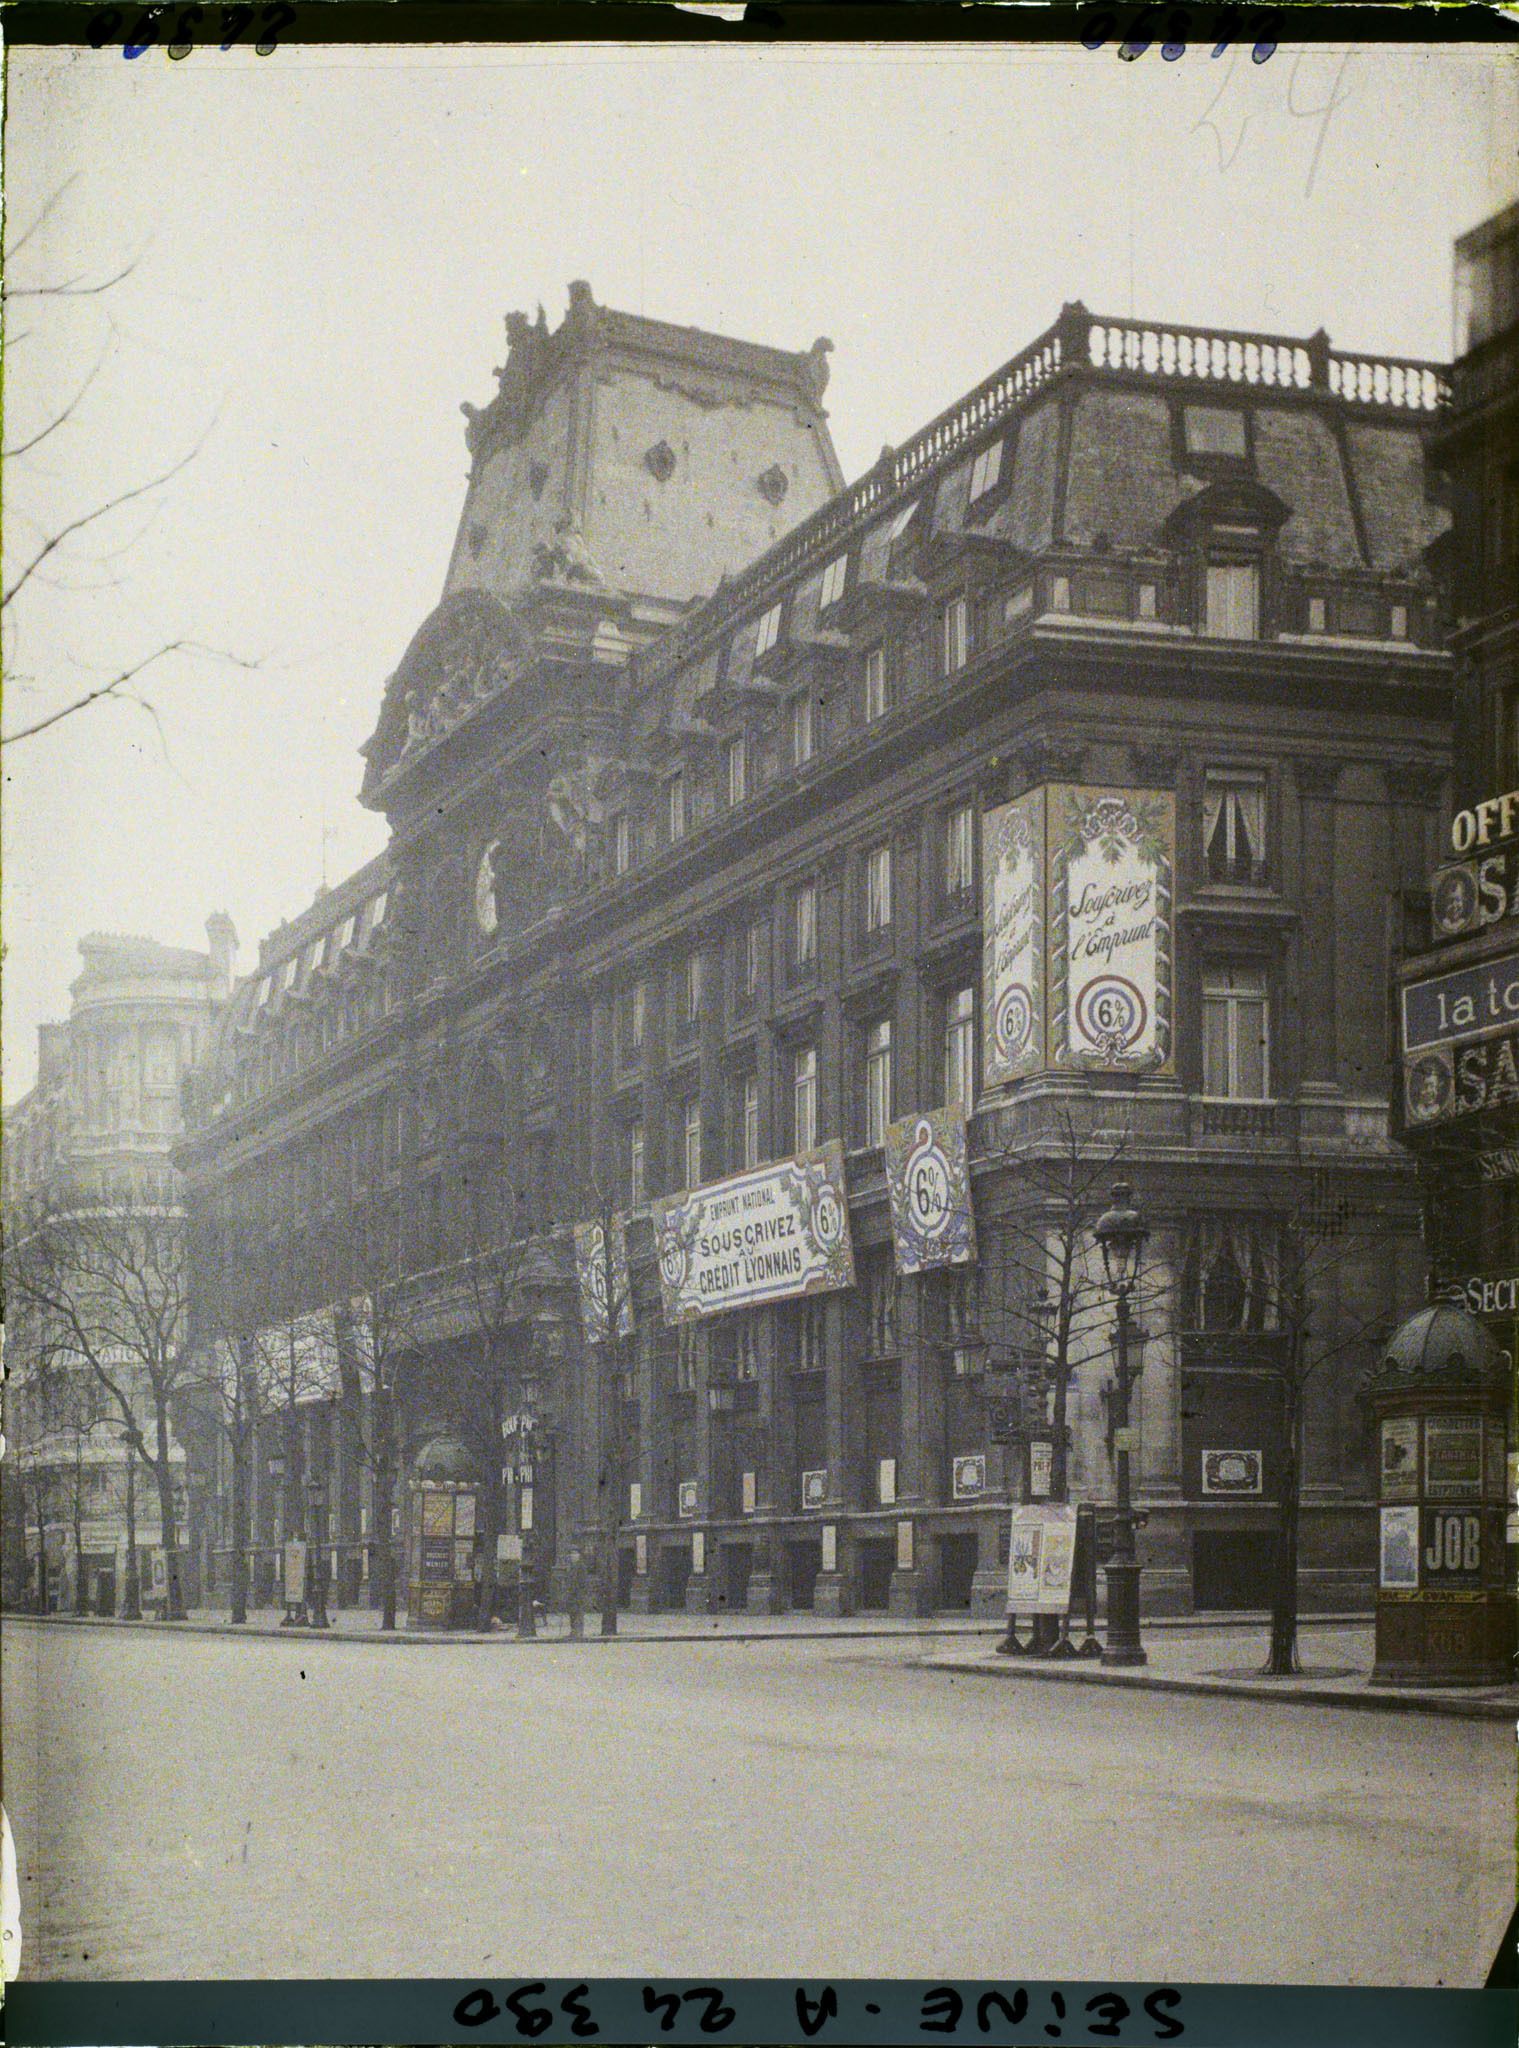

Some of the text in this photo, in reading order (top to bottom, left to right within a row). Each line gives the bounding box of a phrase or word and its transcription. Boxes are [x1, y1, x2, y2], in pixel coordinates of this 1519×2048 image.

[1099, 999, 1125, 1028] 6%
[1437, 992, 1476, 1030] la
[710, 1187, 776, 1222] EMPRUNT NATIONAL
[916, 1166, 942, 1217] 6%
[701, 1214, 796, 1257] SOUSCRIVEZ
[820, 1203, 838, 1234] 6%
[738, 1246, 754, 1258] AU
[744, 1246, 802, 1284] LYONNAIS
[1425, 1516, 1480, 1570] JOB
[452, 1982, 600, 2036] 390
[643, 1988, 735, 2034] 24
[795, 1988, 838, 2035] A
